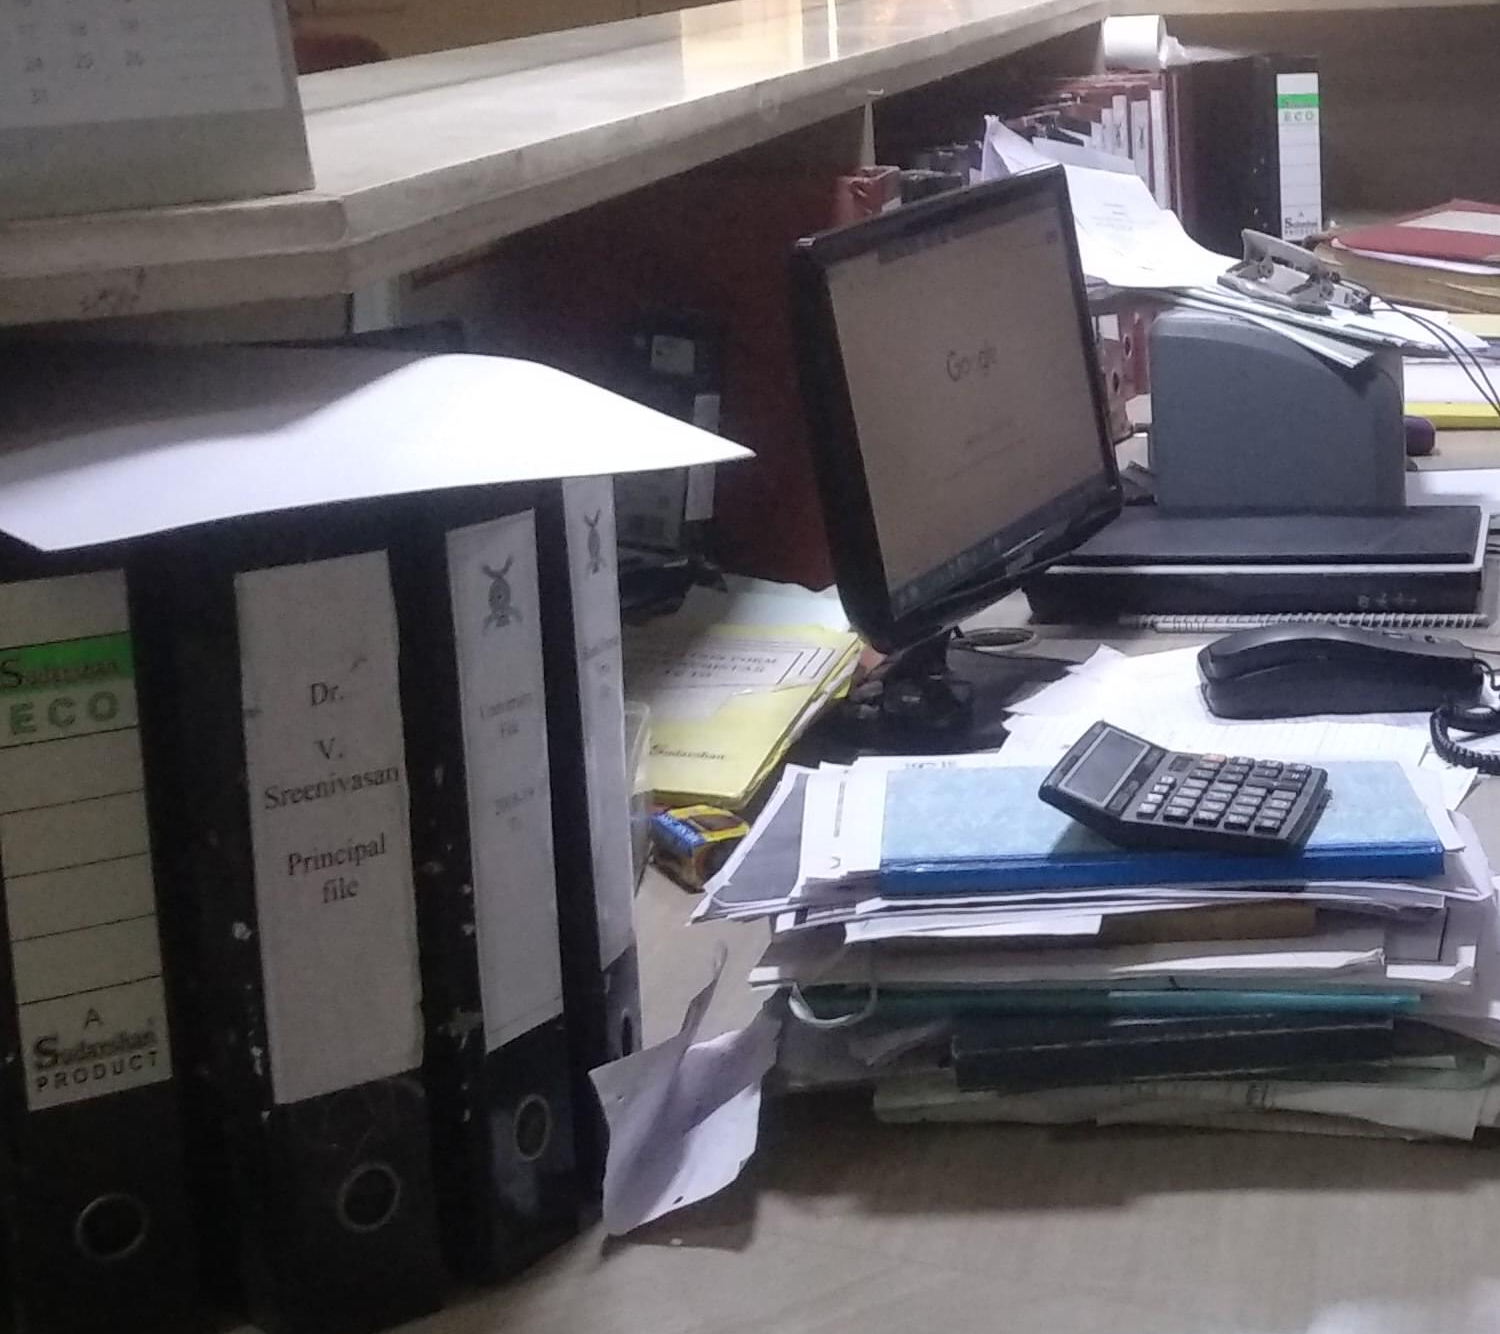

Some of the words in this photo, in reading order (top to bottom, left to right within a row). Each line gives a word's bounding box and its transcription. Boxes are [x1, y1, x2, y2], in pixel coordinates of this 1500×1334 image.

[1284, 111, 1314, 122] ECO
[309, 681, 345, 707] Dr.
[9, 691, 121, 736] ECO
[313, 735, 344, 761] V.
[264, 765, 400, 810] Sreenivasan
[287, 831, 386, 876] Principal
[321, 875, 360, 904] file
[83, 1006, 105, 1029] A
[34, 1048, 158, 1091] PRODUCT
